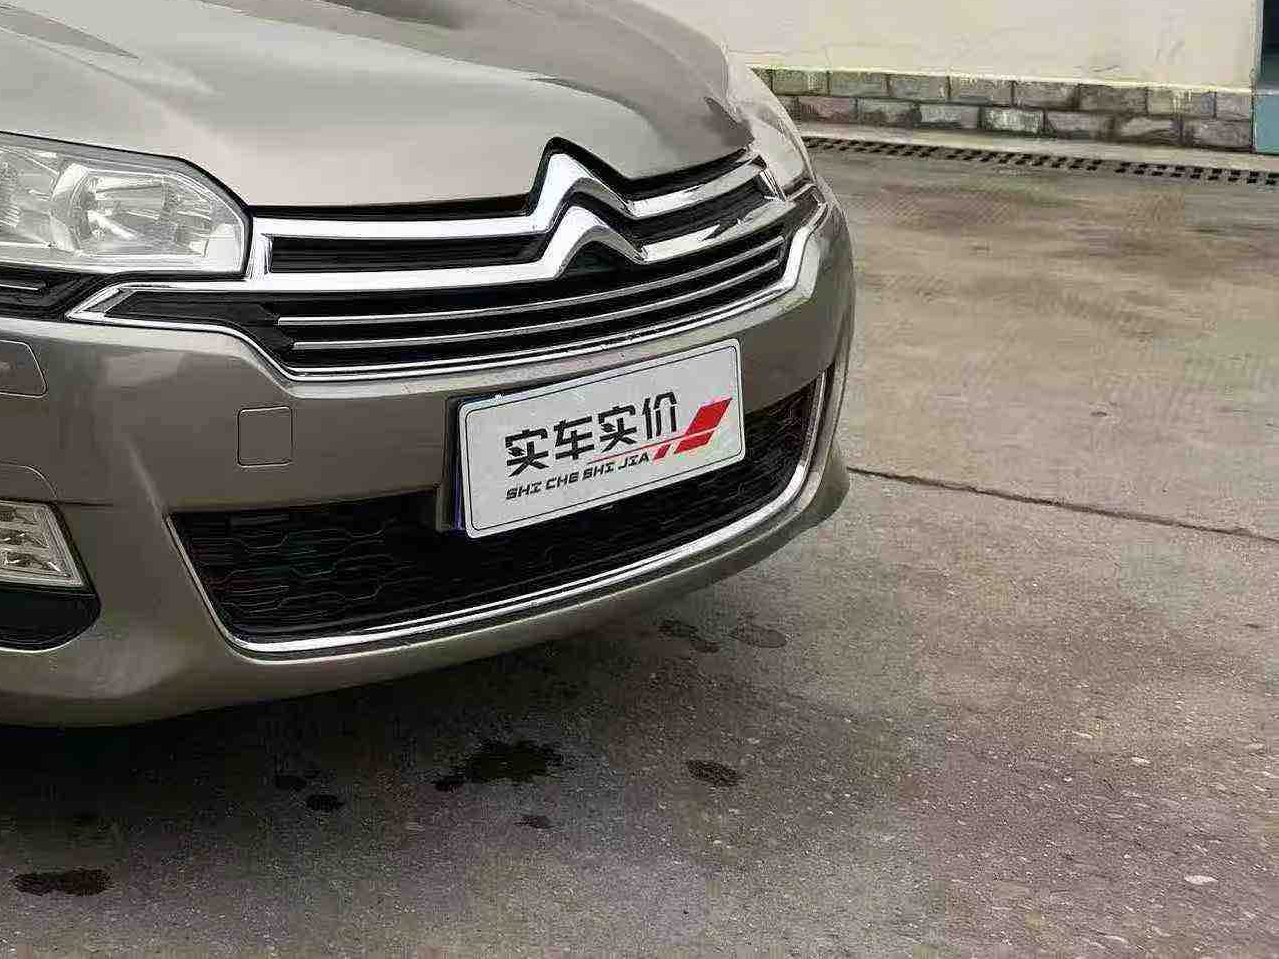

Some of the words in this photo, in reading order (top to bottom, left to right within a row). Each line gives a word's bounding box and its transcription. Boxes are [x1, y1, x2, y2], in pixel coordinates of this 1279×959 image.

[505, 391, 678, 477] 实车实价
[505, 481, 542, 500] SHI
[545, 472, 580, 490] CHE
[582, 461, 616, 480] SHI
[618, 452, 650, 470] JIA
